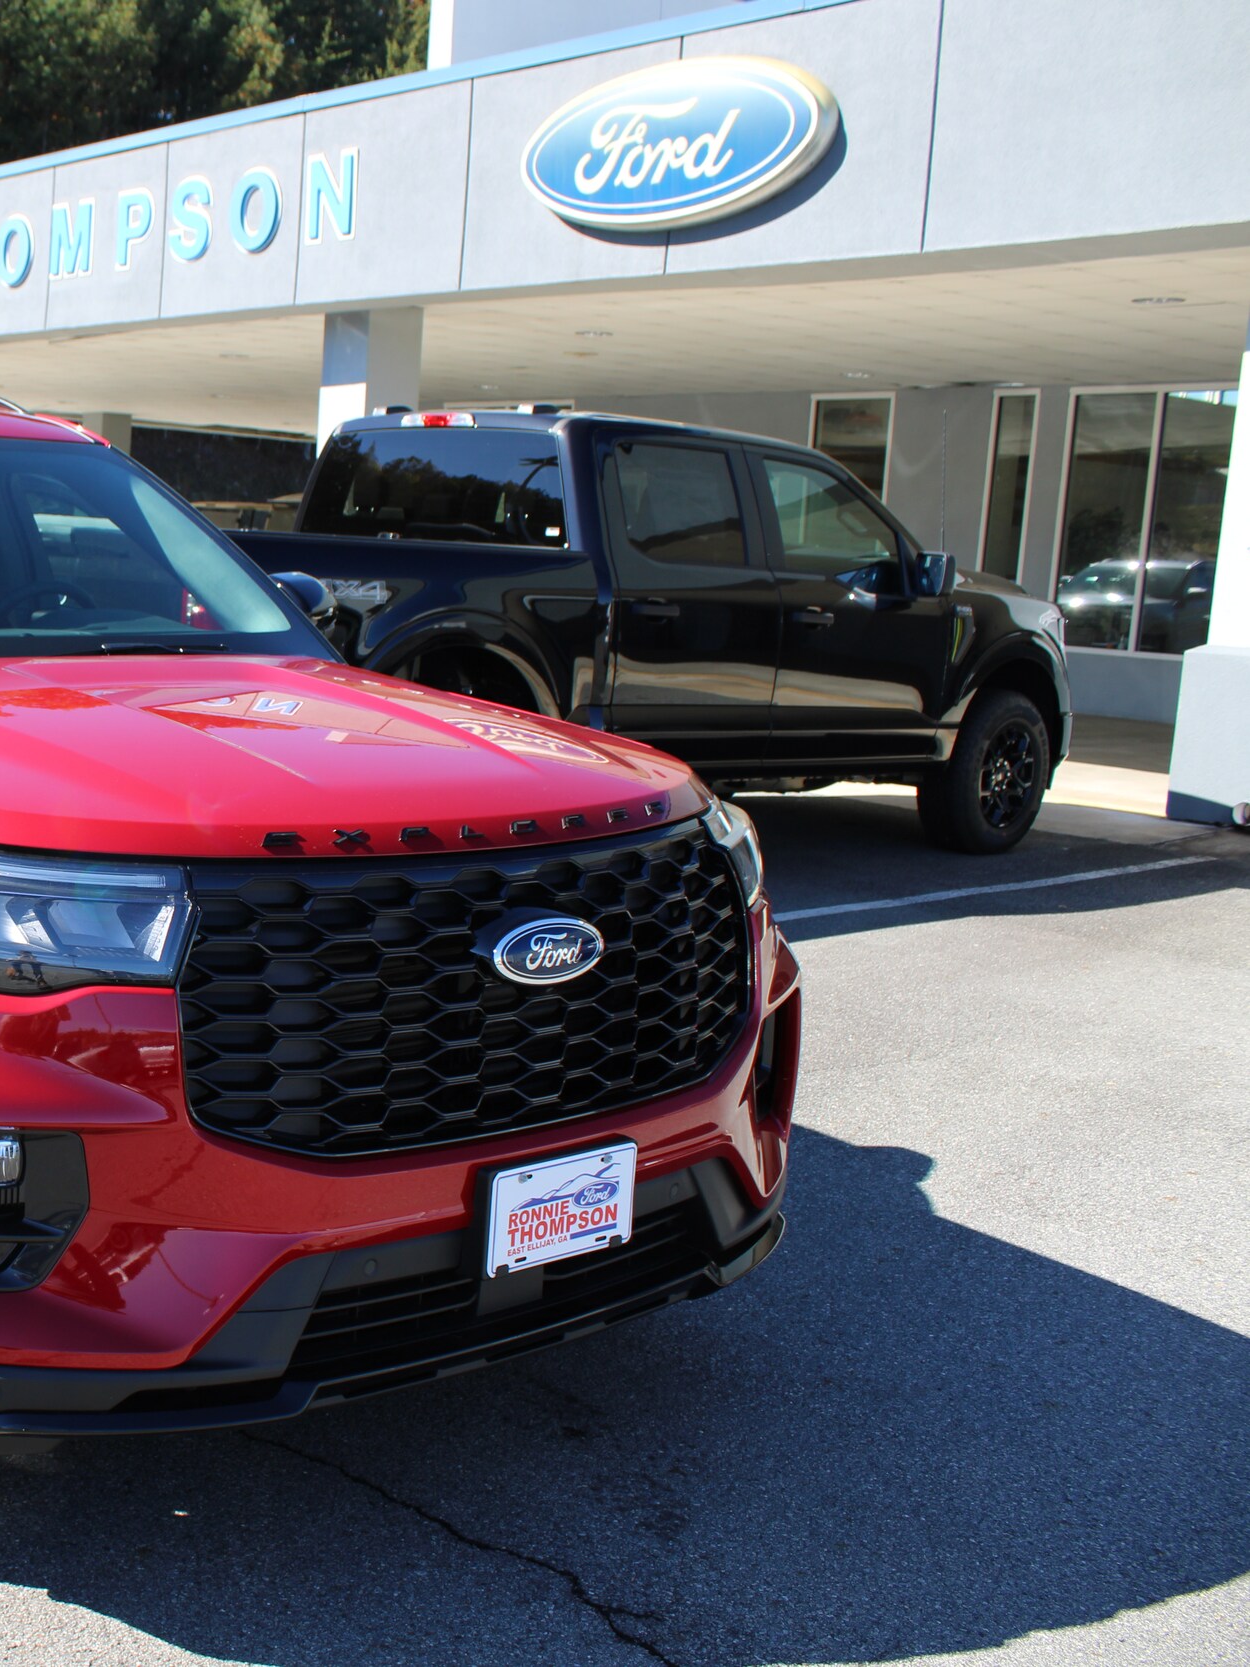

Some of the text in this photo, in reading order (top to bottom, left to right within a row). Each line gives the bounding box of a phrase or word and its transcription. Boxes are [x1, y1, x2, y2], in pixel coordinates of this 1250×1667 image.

[574, 97, 740, 195] Ford
[319, 578, 388, 604] X4
[261, 801, 664, 848] EXPLORER
[525, 932, 582, 970] Ford
[580, 1184, 610, 1205] Ford
[507, 1203, 617, 1246] THOMPSON
[508, 1200, 570, 1228] RONNIE
[507, 1235, 568, 1257] EAST ELLIJAY, GA
